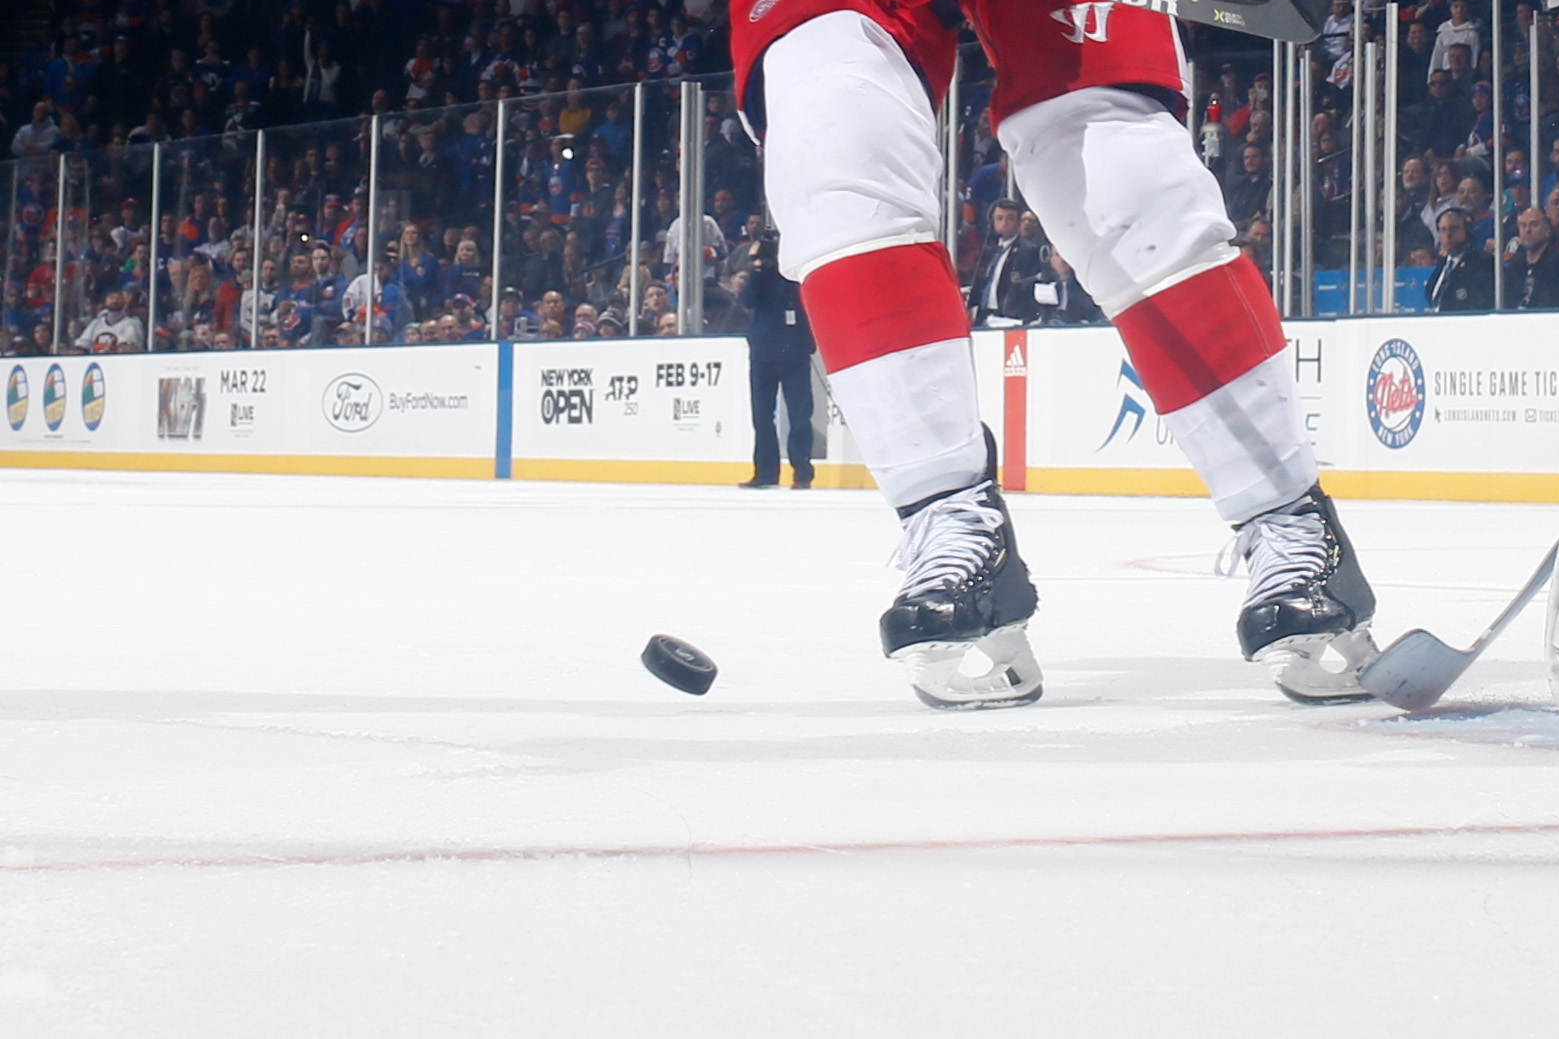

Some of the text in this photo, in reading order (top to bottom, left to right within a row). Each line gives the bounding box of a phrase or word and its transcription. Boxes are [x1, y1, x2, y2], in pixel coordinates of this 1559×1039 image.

[220, 369, 267, 393] MAR 22
[541, 368, 593, 387] NEW YORK
[604, 375, 639, 401] ATP
[656, 362, 722, 388] FEB 9-17
[1434, 371, 1483, 396] SINGLE
[1489, 371, 1528, 397] GAME
[332, 381, 373, 422] Ford
[389, 392, 468, 413] BuyFordNow.com
[541, 388, 595, 424] OPEN
[1374, 367, 1418, 419] Nets
[238, 406, 254, 421] LIVE
[682, 400, 700, 415] LIVE
